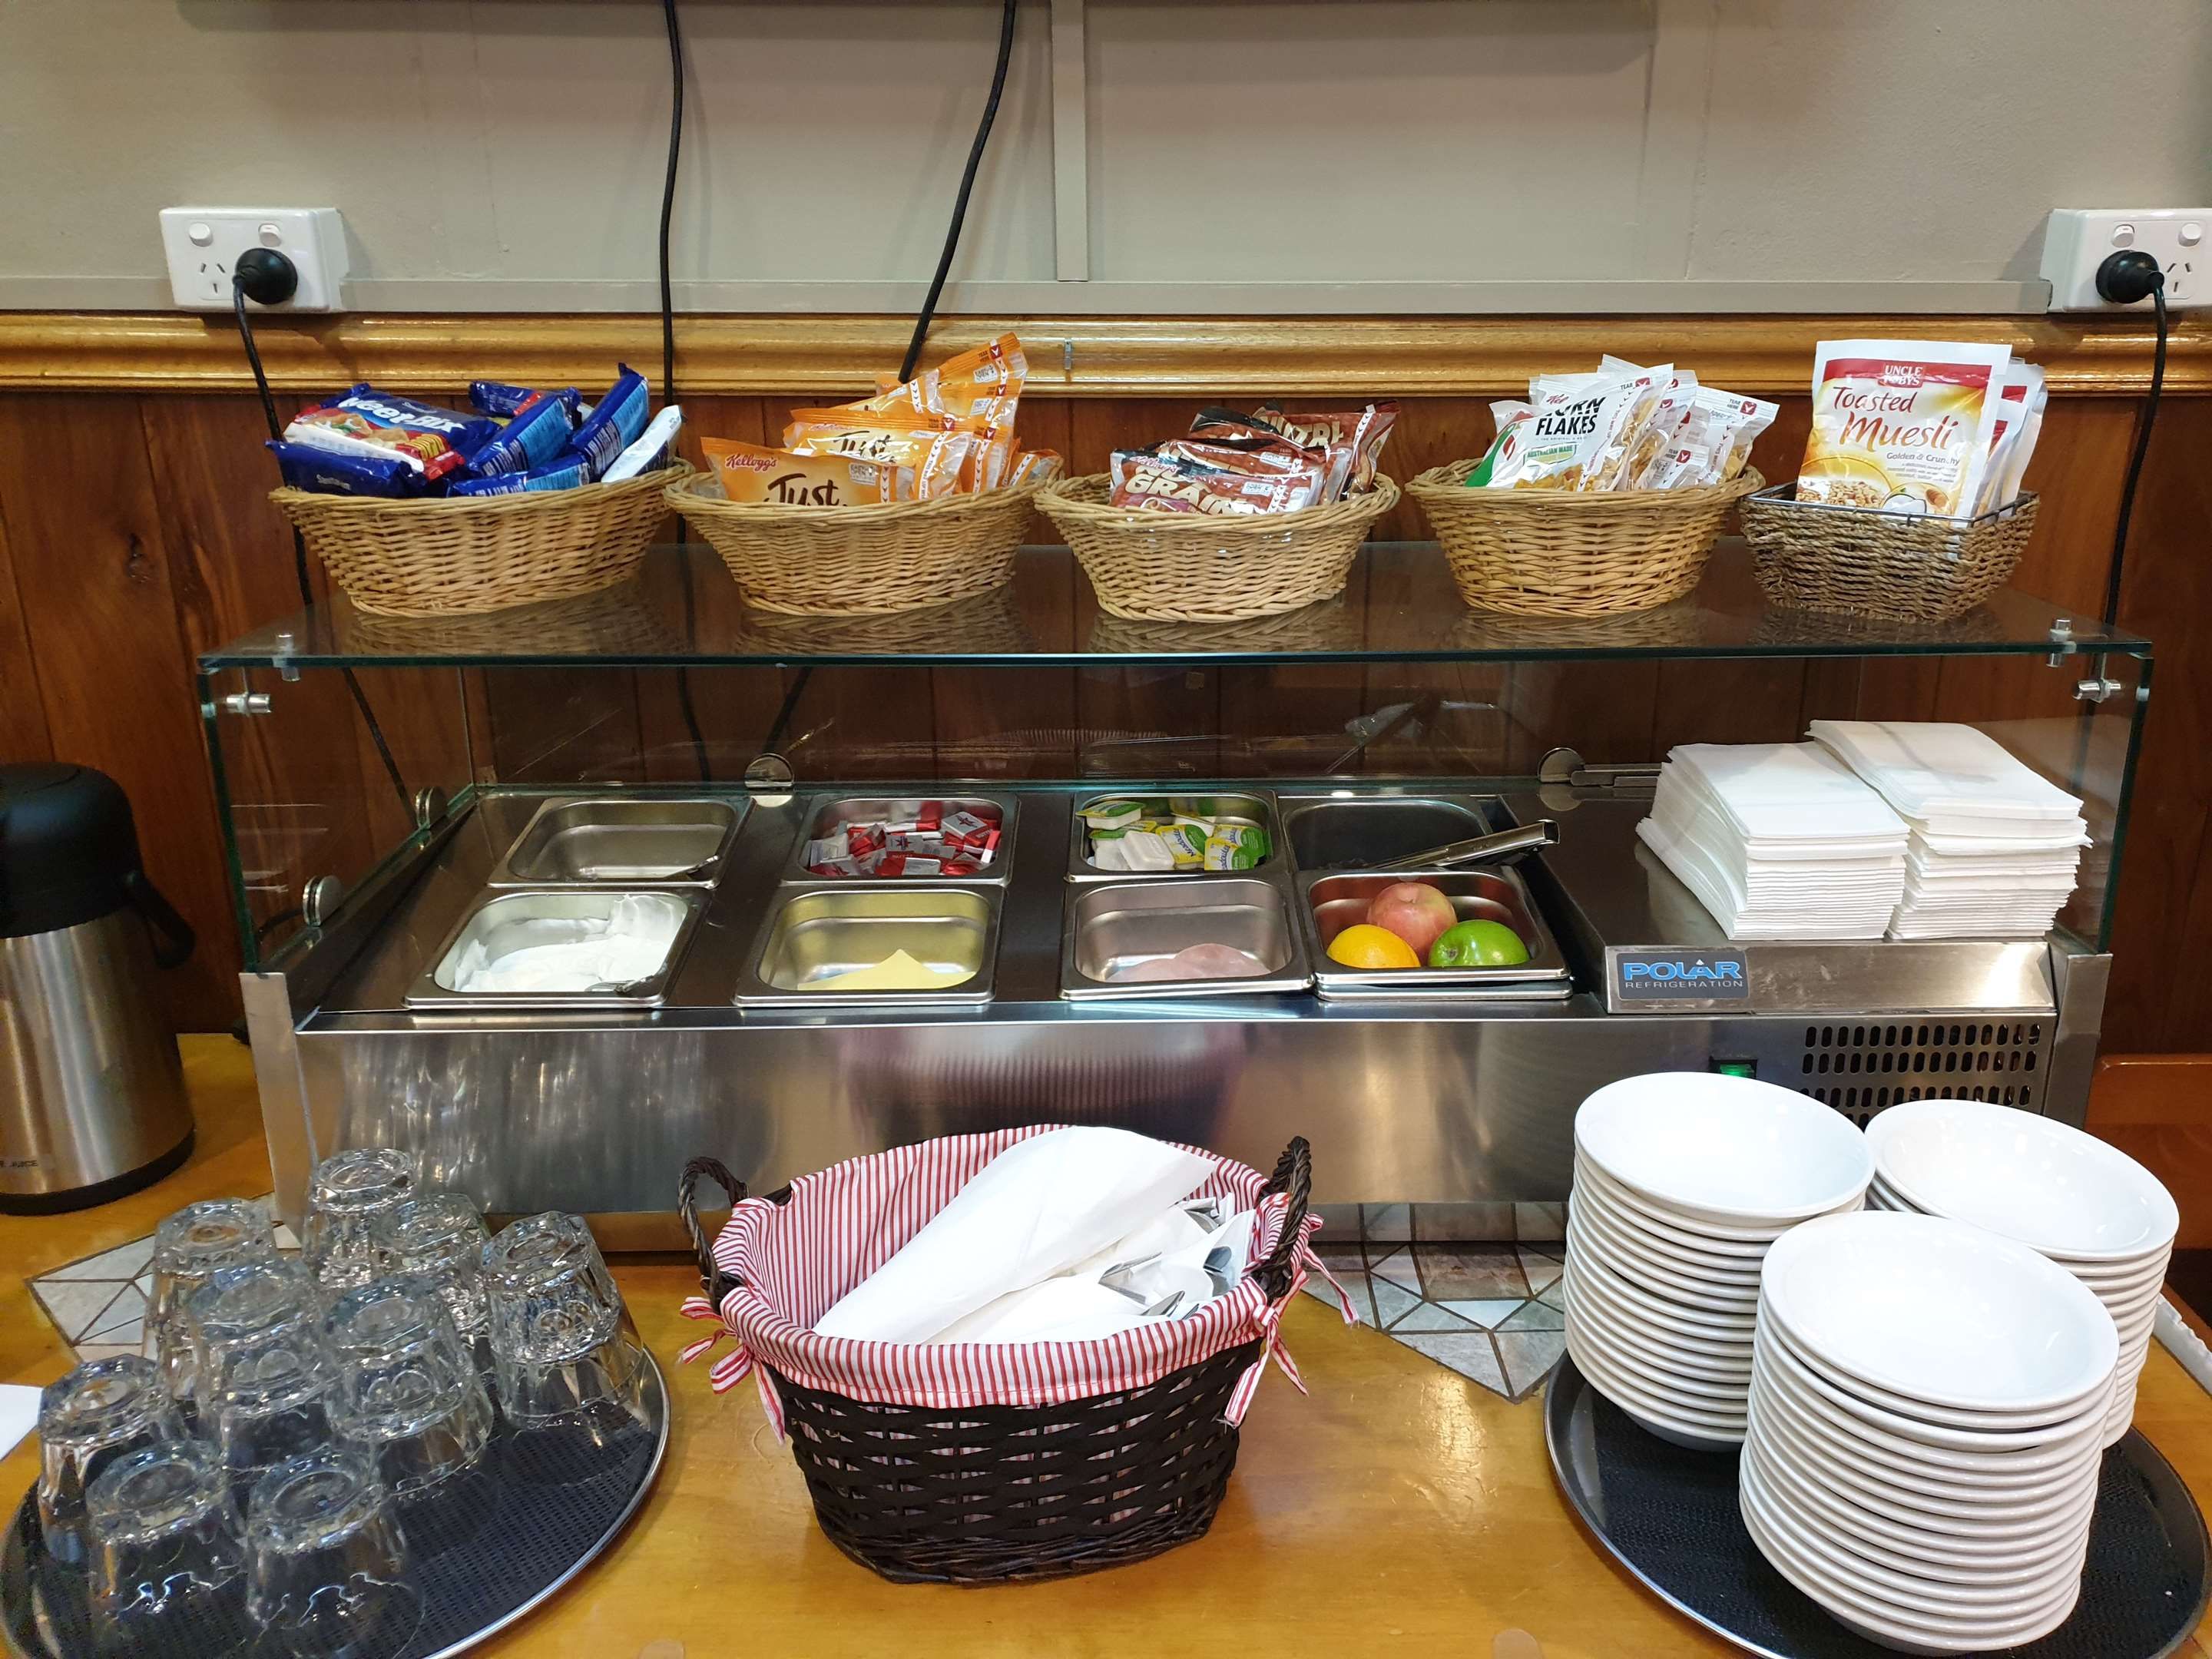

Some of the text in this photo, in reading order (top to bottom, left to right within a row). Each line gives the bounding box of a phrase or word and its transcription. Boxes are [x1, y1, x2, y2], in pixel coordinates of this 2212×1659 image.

[1885, 365, 1922, 376] UNCLE
[1833, 386, 1917, 412] Toasted
[1536, 414, 1598, 435] FLAKES
[1839, 411, 1959, 452] Muesli
[726, 453, 778, 472] Kellogg's
[1528, 447, 1558, 458] AUSTRALIAN
[764, 473, 839, 506] Just
[1623, 959, 1743, 981] POLAR
